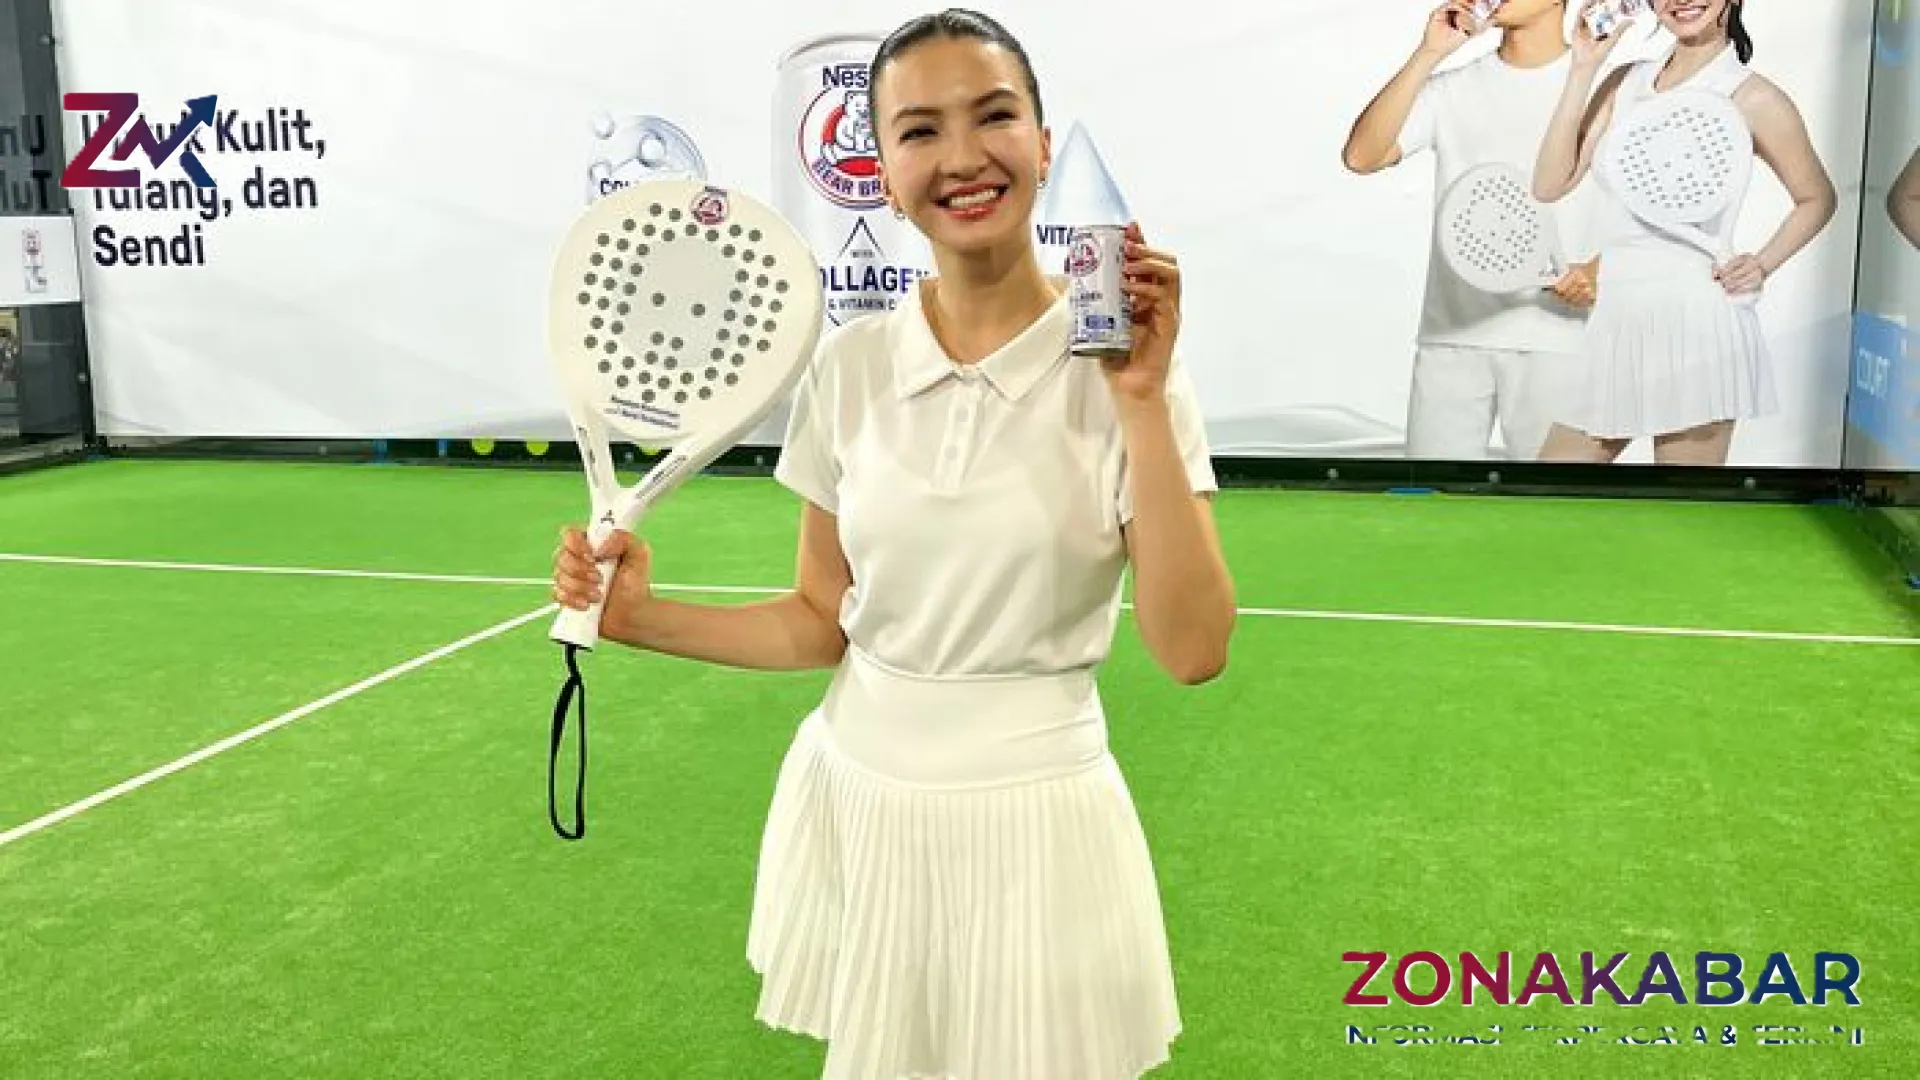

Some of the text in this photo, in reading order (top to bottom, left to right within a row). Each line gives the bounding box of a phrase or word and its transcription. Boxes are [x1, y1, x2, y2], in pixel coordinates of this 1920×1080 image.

[822, 63, 868, 88] Nes
[215, 107, 327, 160] Kulit,
[243, 166, 319, 209] dan
[92, 223, 206, 267] Sendi
